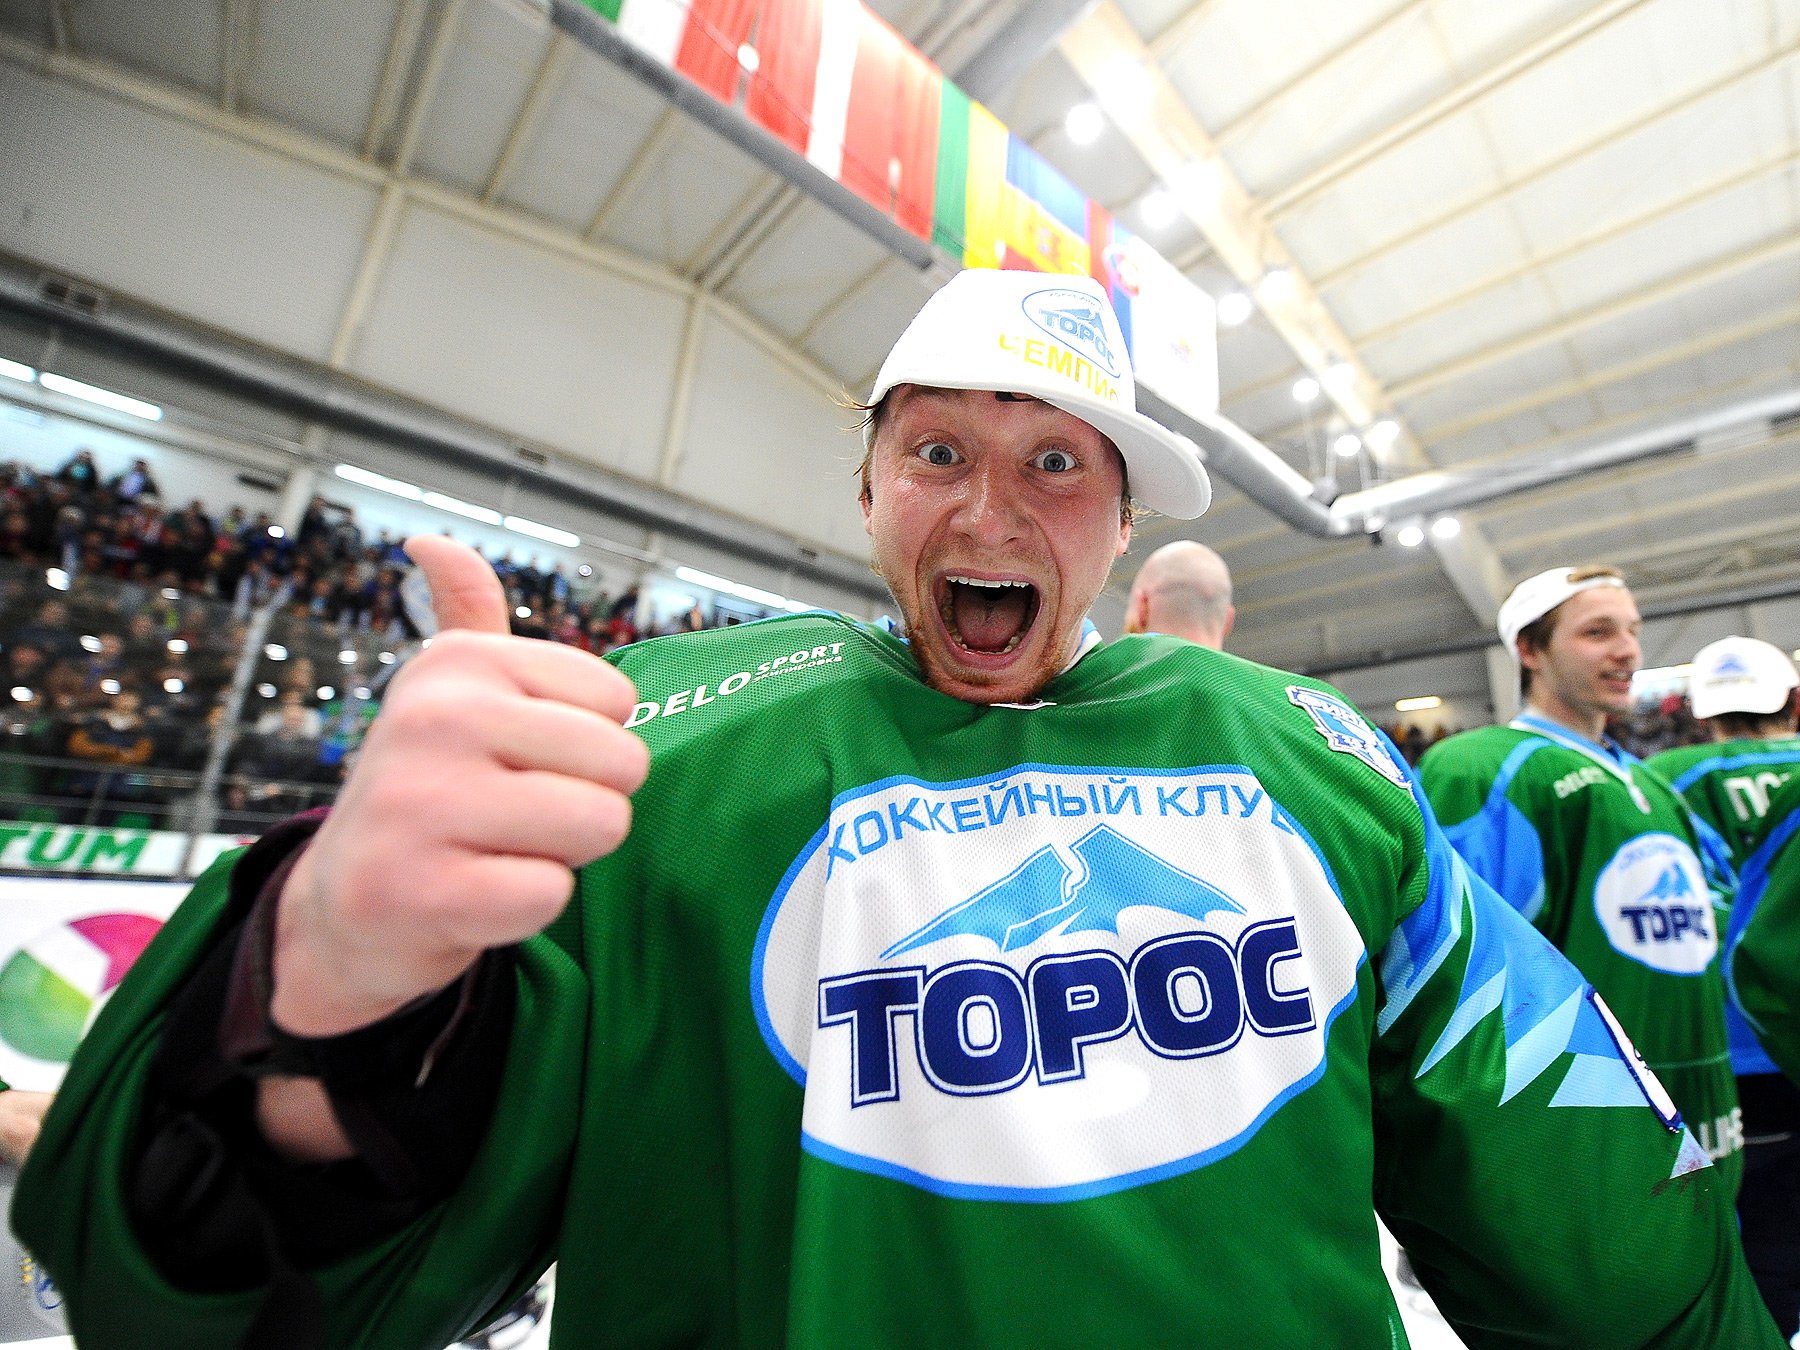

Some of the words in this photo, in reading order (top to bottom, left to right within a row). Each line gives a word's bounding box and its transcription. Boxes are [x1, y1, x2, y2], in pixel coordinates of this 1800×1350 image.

[623, 671, 752, 729] DELO
[754, 642, 845, 676] SPORT
[825, 777, 1142, 883] ХОККЕЙНЫЙ
[818, 915, 1317, 1109] ТОРОС
